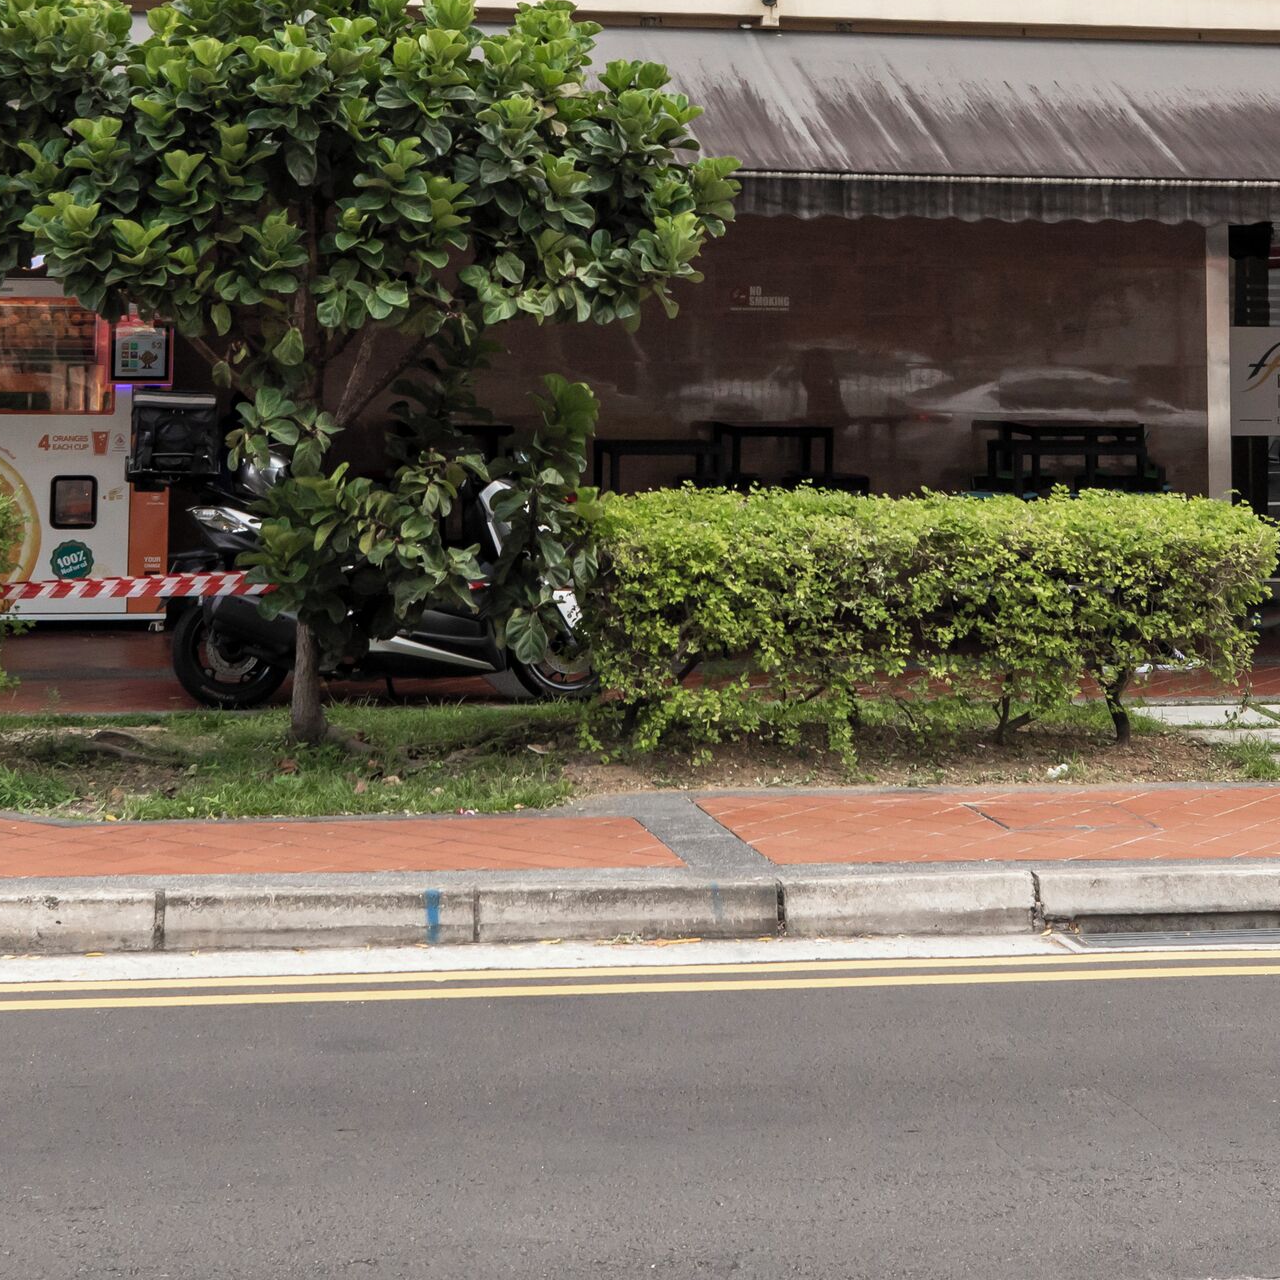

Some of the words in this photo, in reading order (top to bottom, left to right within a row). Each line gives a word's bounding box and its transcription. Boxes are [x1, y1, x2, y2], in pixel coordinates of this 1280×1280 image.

[749, 286, 762, 296] NO
[749, 296, 790, 307] SMOKING
[38, 433, 50, 451] 4
[52, 443, 73, 451] EACH
[74, 443, 89, 451] CUP
[57, 550, 86, 568] 100%
[61, 560, 88, 575] Natural
